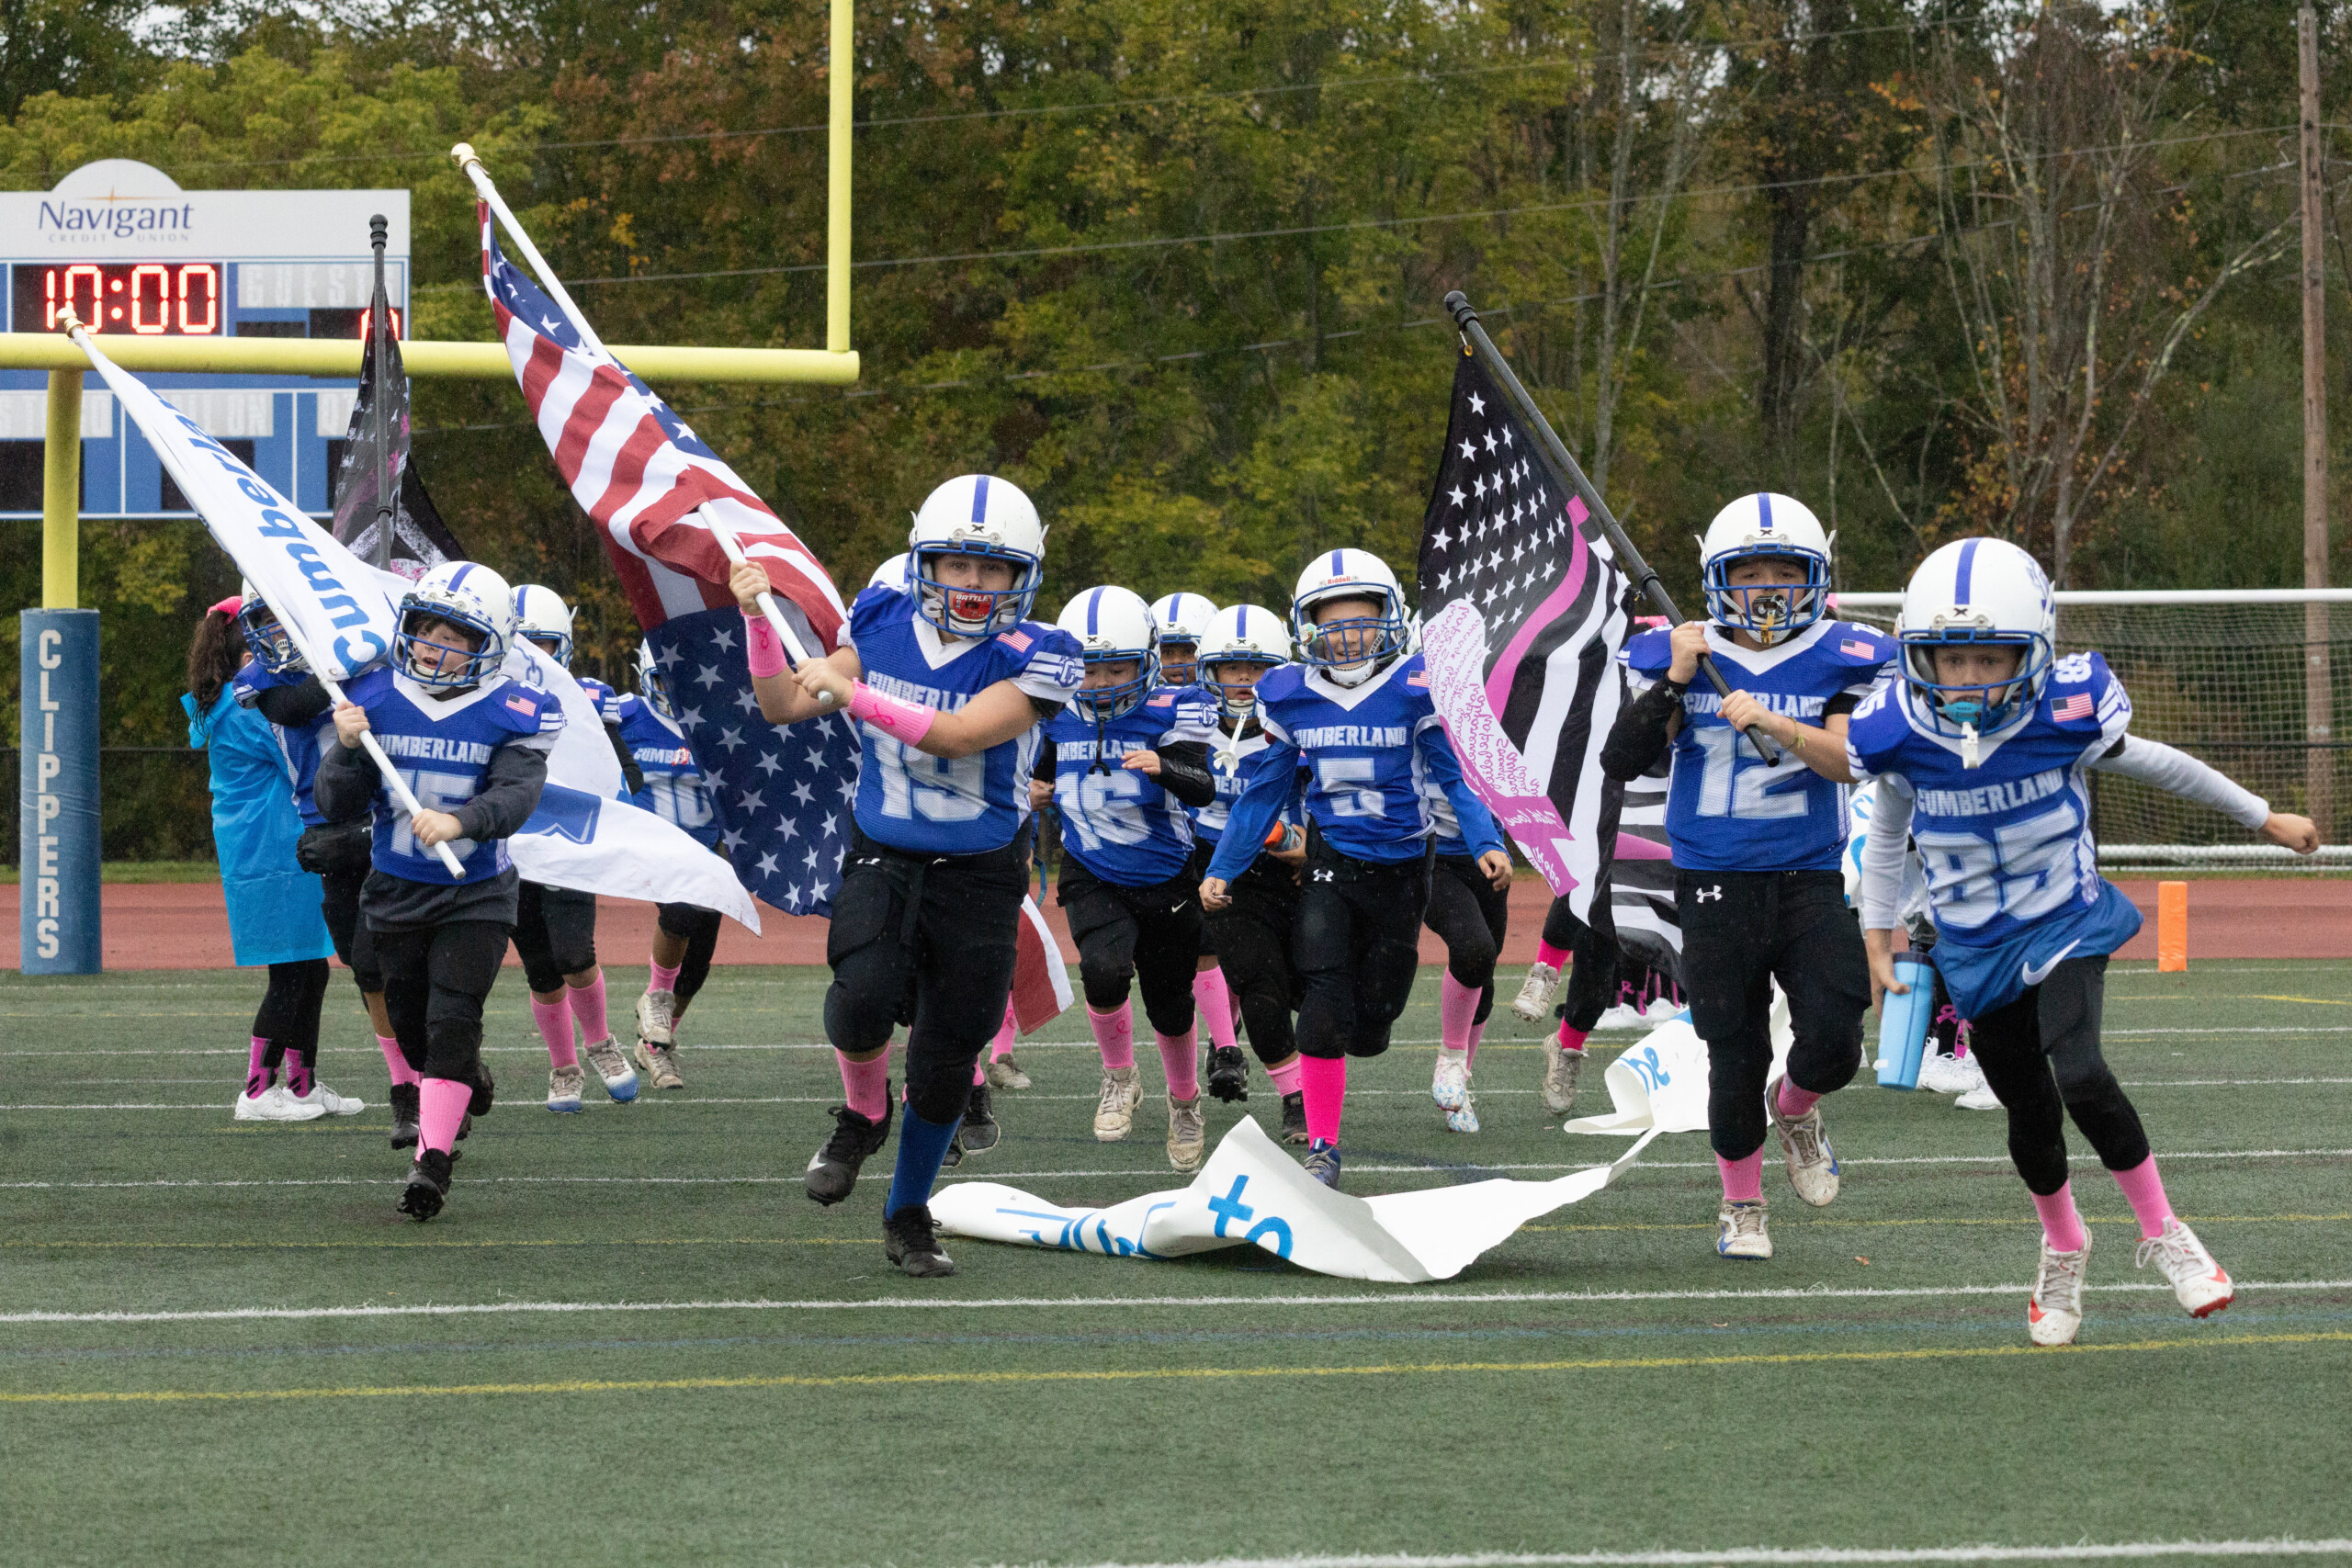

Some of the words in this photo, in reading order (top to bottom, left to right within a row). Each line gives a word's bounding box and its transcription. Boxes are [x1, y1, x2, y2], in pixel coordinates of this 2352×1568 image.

[39, 200, 195, 239] Navigant
[49, 233, 107, 243] CREDIT
[138, 233, 189, 243] UNION
[46, 264, 217, 334] 10:00
[956, 593, 989, 603] BATTLE
[1327, 576, 1351, 585] Riddell
[1683, 692, 1827, 718] CUMRLAND
[37, 629, 62, 959] CLIPPERS
[861, 719, 990, 822] 19
[1317, 757, 1387, 819] 5
[1693, 725, 1810, 819] 12
[1917, 768, 2064, 818] CUMBERLAND
[381, 768, 479, 862] 15
[1055, 769, 1153, 852] 16
[1916, 799, 2079, 930] 85
